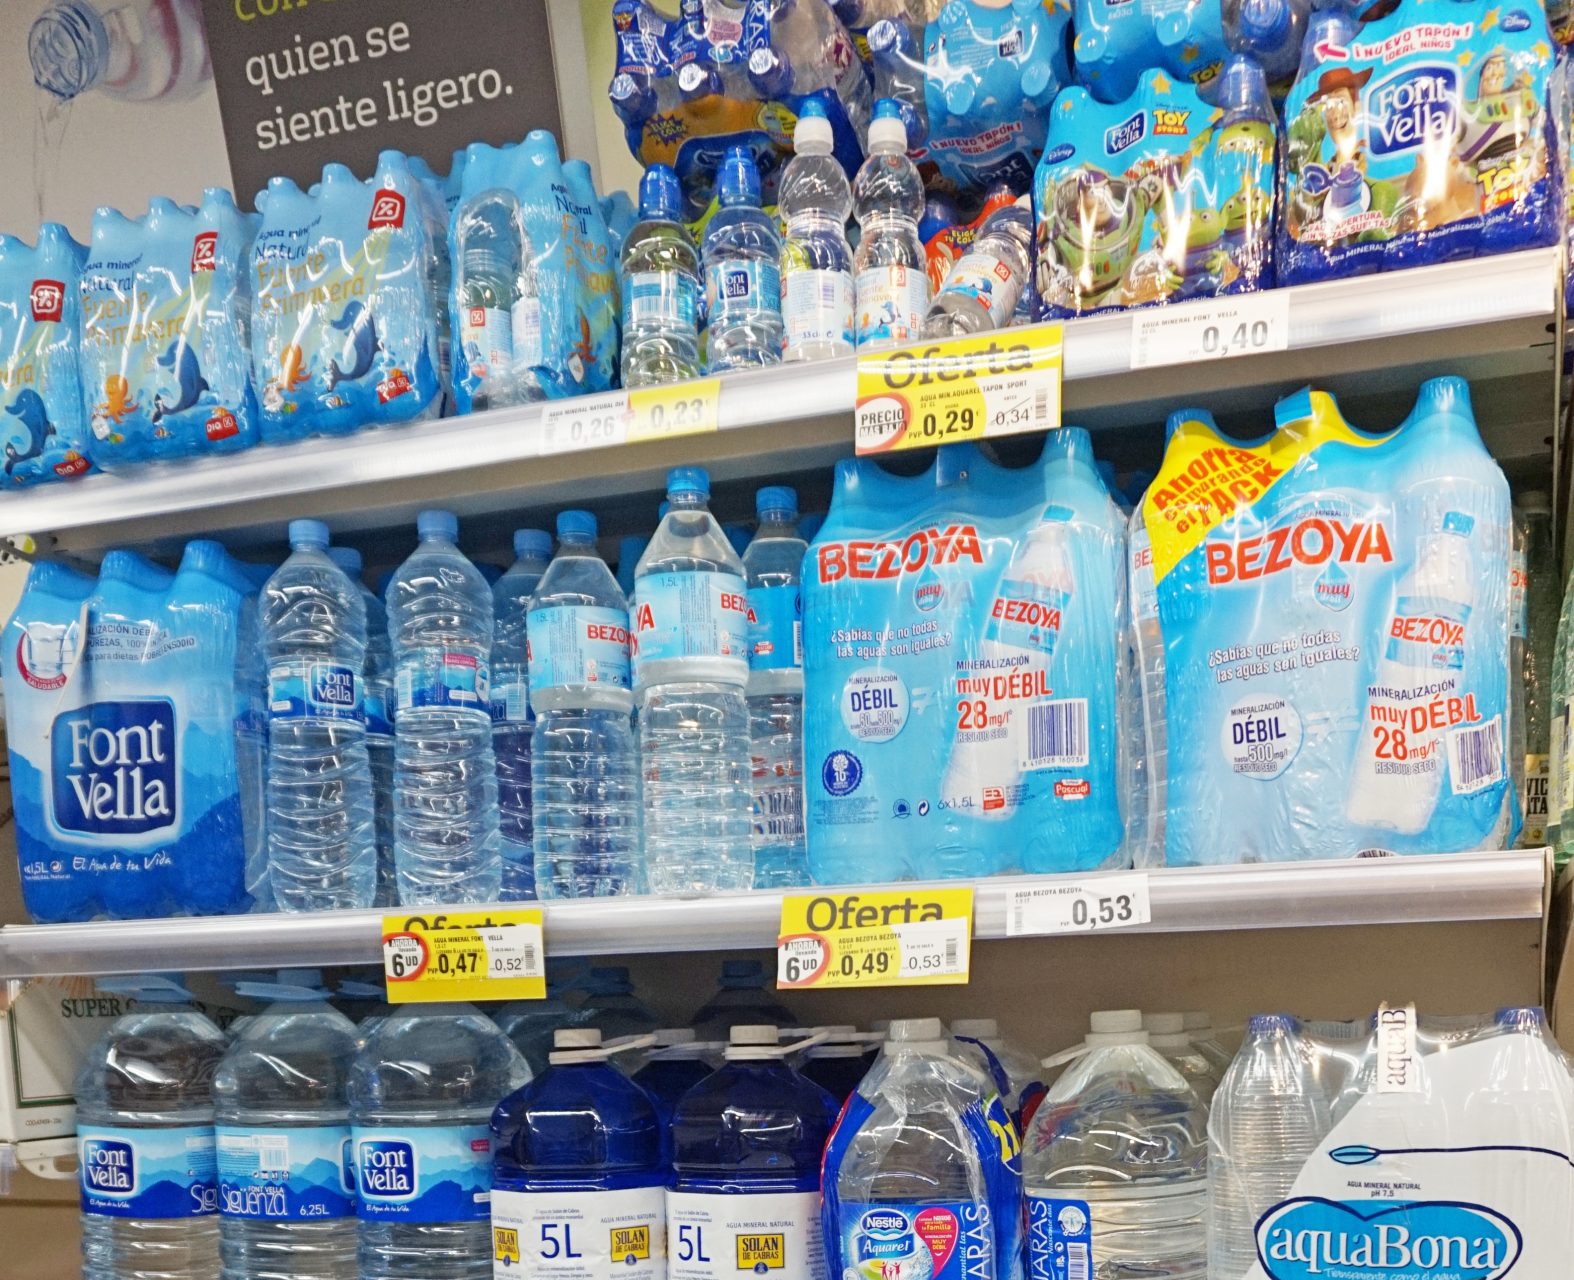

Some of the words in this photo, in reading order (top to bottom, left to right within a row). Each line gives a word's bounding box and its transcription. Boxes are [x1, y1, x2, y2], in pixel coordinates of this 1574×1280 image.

[1501, 12, 1531, 31] Disney
[246, 34, 359, 95] quien
[366, 21, 410, 58] se
[1378, 69, 1446, 112] Font
[256, 96, 377, 149] siente
[383, 69, 513, 126] ligero.
[1153, 110, 1192, 126] TOY
[1110, 119, 1141, 141] Font
[1154, 123, 1187, 135] STORY
[1378, 106, 1448, 152] Vella
[1047, 147, 1073, 161] Disney
[1110, 133, 1141, 152] Vella
[1478, 157, 1530, 193] TOY
[1202, 320, 1268, 357] 0,40
[883, 342, 1033, 389] Oferta
[651, 398, 703, 431] 0,23
[861, 408, 904, 425] PRECIO
[923, 408, 974, 439] 0,29
[995, 408, 1029, 427] 0,34
[571, 416, 615, 443] 0,26
[908, 431, 921, 439] PVP
[1153, 447, 1257, 510] Ahorra
[1191, 461, 1285, 526] PACK
[818, 525, 983, 584] BEZOYA
[1206, 518, 1392, 584] BEZOYA
[1317, 582, 1350, 597] muy
[992, 598, 1061, 630] BEZOYA
[898, 627, 909, 638] no
[911, 621, 937, 636] todas
[1390, 617, 1464, 646] BEZOYA
[837, 645, 853, 658] las
[856, 644, 887, 660] aguas
[890, 642, 909, 656] son
[911, 634, 951, 654] iguales?
[1208, 646, 1254, 668] ¿Sabías
[1257, 643, 1279, 657] que
[1282, 639, 1298, 651] no
[1302, 630, 1341, 647] todas
[957, 656, 1029, 669] MINERALIZACIÓN
[1216, 668, 1232, 682] las
[1236, 662, 1269, 680] aguas
[1274, 658, 1298, 671] son
[1301, 646, 1359, 668] iguales?
[316, 669, 350, 687] Font
[957, 677, 990, 697] muy
[994, 670, 1052, 700] DÉBIL
[1368, 679, 1455, 699] MINERALIZACIÓN
[316, 683, 352, 703] Vella
[851, 686, 898, 712] DÉBIL
[957, 701, 987, 730] 28
[1231, 701, 1285, 716] MINERALIZACIÓN
[1371, 703, 1408, 730] muy
[1410, 693, 1480, 734] DÉBIL
[68, 719, 164, 769] Font
[1232, 717, 1286, 746] DÉBIL
[1374, 727, 1408, 760] 28
[66, 767, 169, 821] Vella
[1055, 783, 1088, 795] Pascual
[1033, 889, 1056, 897] BEZOYA
[1058, 887, 1082, 895] BEZOYA
[806, 897, 943, 932] Oferta
[1072, 895, 1133, 929] 0,53
[786, 941, 820, 950] AHORRA
[392, 956, 404, 976] 6
[438, 952, 478, 977] 0,47
[495, 958, 522, 973] 0,52
[786, 957, 800, 982] 6
[803, 957, 817, 970] UD
[841, 952, 889, 981] 0,49
[908, 955, 941, 971] 0,53
[61, 997, 122, 1018] SUPER
[87, 1145, 127, 1166] Font
[363, 1145, 406, 1167] Font
[87, 1163, 130, 1187] Vella
[363, 1164, 408, 1190] Vella
[221, 1187, 288, 1216] Sigüenza
[300, 1204, 329, 1216] 6,25L
[540, 1223, 582, 1259] 5L
[615, 1228, 645, 1243] SOLAN
[678, 1225, 711, 1262] 5L
[742, 1237, 779, 1252] SOLAN
[863, 1240, 909, 1256] Aquarel
[1269, 1224, 1500, 1273] aquaBona
[754, 1250, 780, 1259] CABRAS
[1421, 1270, 1430, 1280] el
